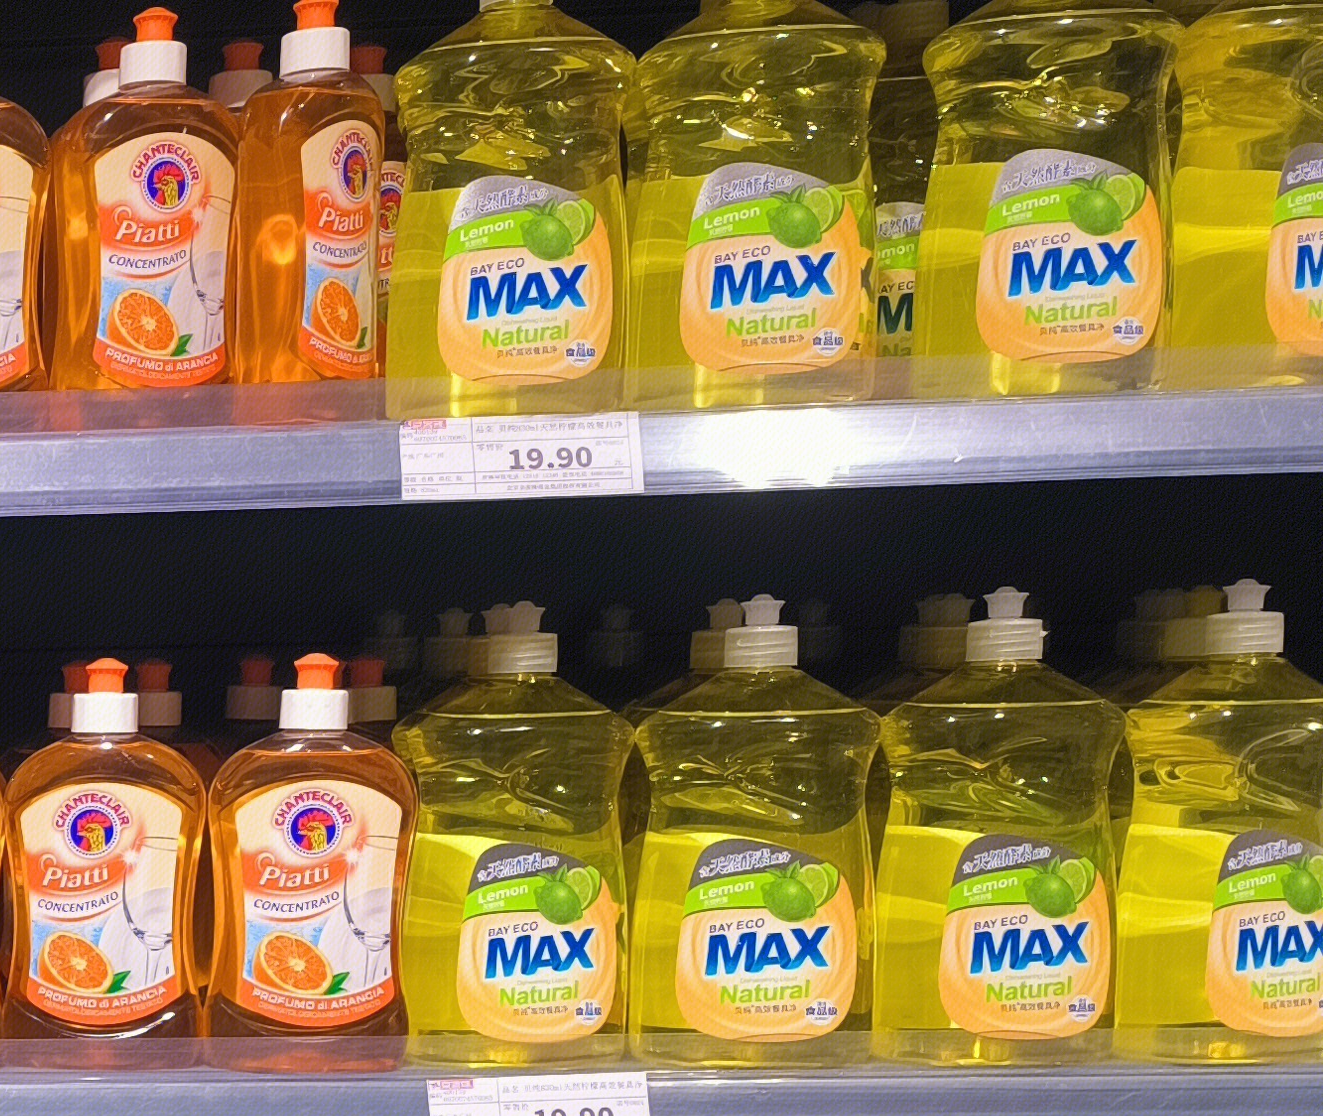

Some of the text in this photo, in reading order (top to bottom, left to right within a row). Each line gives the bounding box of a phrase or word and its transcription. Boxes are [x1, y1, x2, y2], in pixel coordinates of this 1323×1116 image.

[131, 142, 199, 182] CHANTECLAIR
[460, 217, 514, 241] Lemon
[703, 205, 760, 230] Lemon
[115, 220, 179, 243] Piatti
[1012, 232, 1071, 252] BAY ECO
[108, 250, 187, 270] CONCENTRATO
[1008, 240, 1137, 298] MAX
[466, 264, 588, 321] MAX
[710, 252, 836, 310] MAX
[1024, 296, 1117, 326] Natural
[482, 320, 570, 350] Natural
[509, 447, 592, 470] 19.90
[56, 793, 130, 829] CHANTECLAIR
[258, 863, 330, 888] Piatti
[964, 875, 1018, 897] Lemon
[254, 891, 340, 912] CONCENTRATO
[974, 915, 1028, 931] BAY ECO
[485, 928, 595, 980] MAX
[706, 926, 830, 976] MAX
[970, 922, 1089, 974] MAX
[253, 988, 314, 1008] PROFUMO
[330, 987, 384, 1008] ARANCIA
[720, 980, 810, 1006] Natural
[1251, 976, 1320, 1001] Natural
